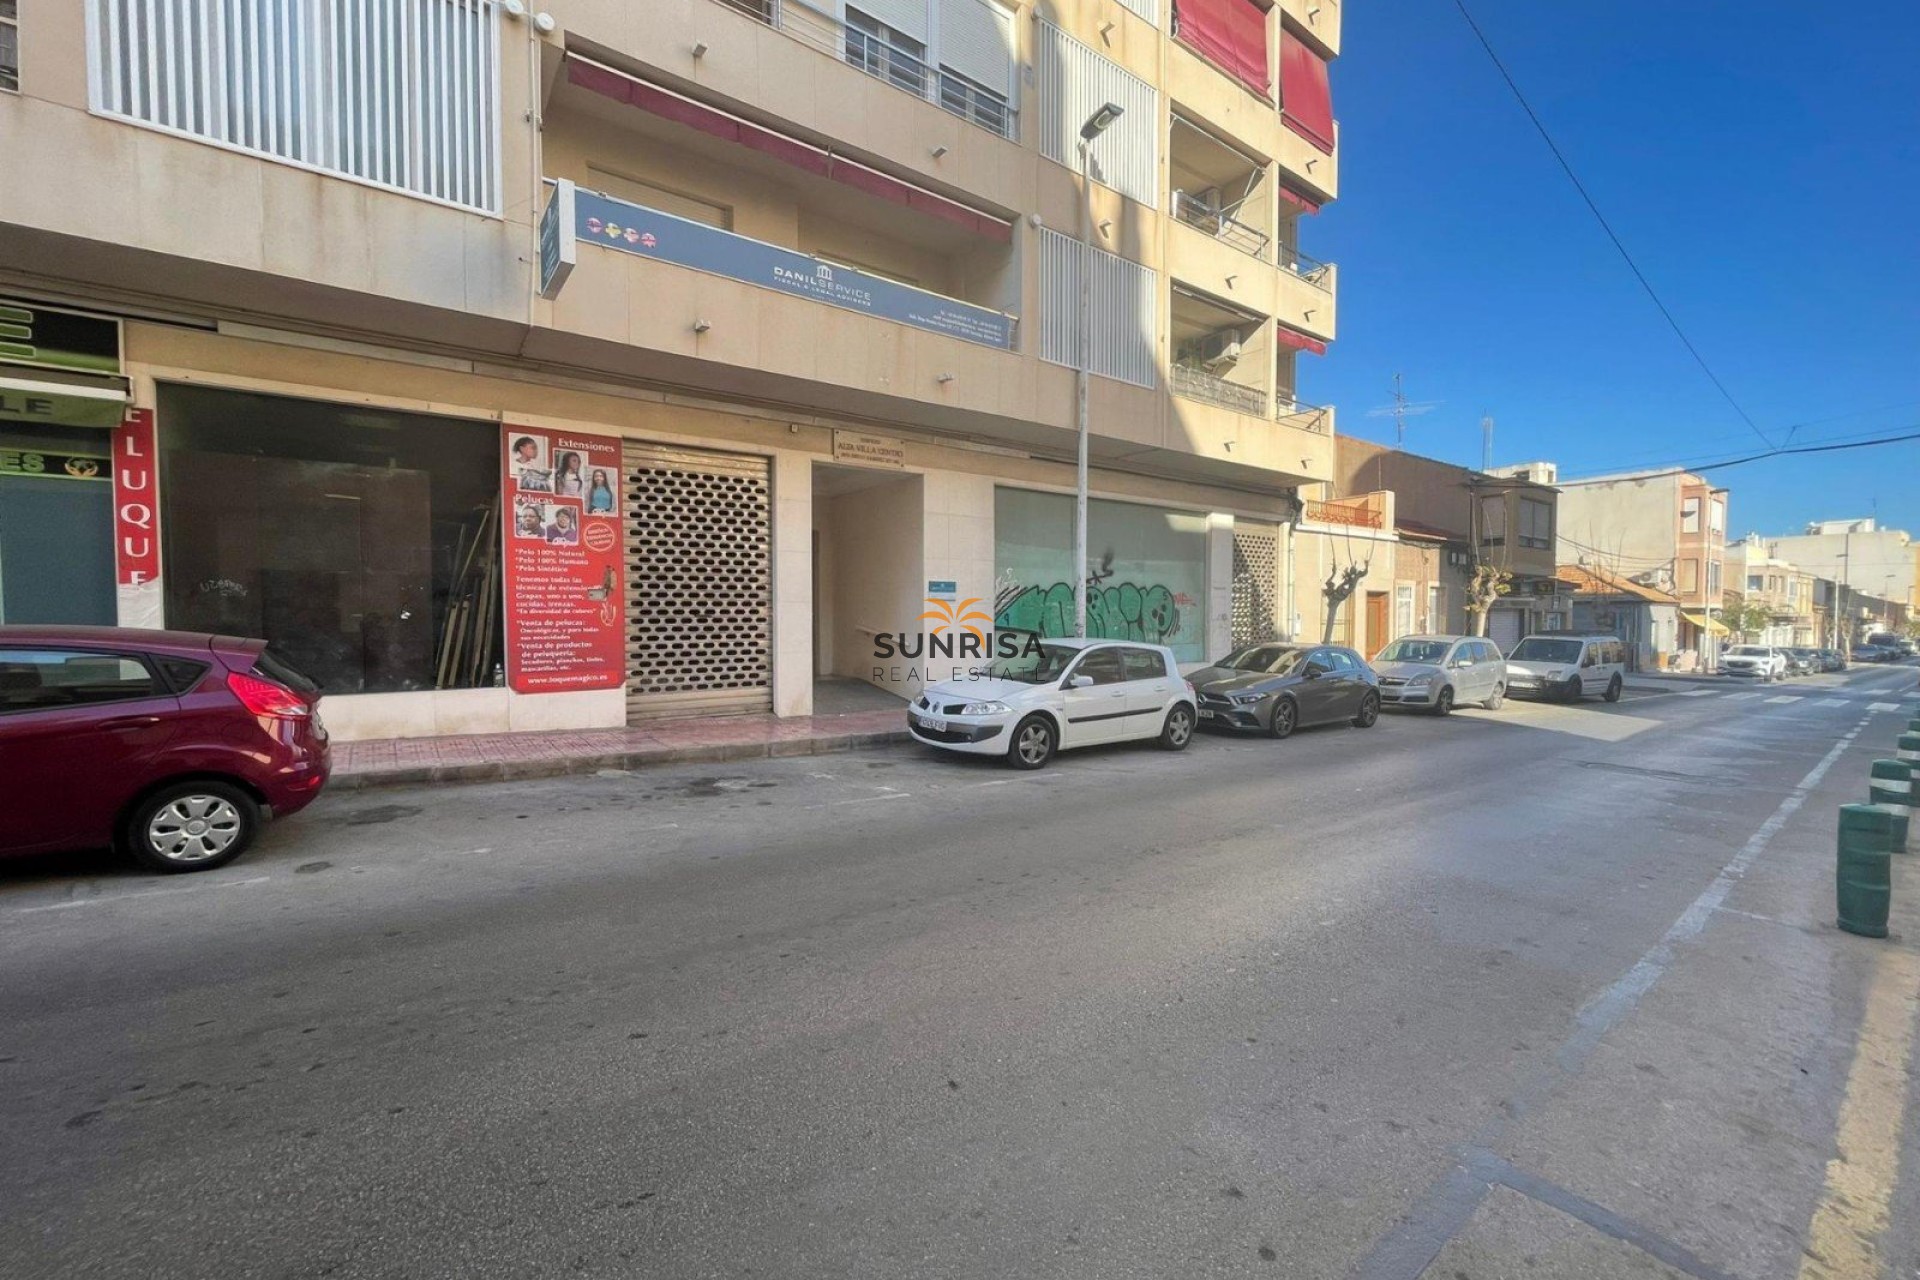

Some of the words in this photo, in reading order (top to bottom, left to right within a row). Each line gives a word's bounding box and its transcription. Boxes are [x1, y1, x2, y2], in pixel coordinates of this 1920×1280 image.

[558, 438, 615, 453] Extensiones
[514, 493, 554, 505] Pelucas
[515, 575, 549, 583] Tenemos
